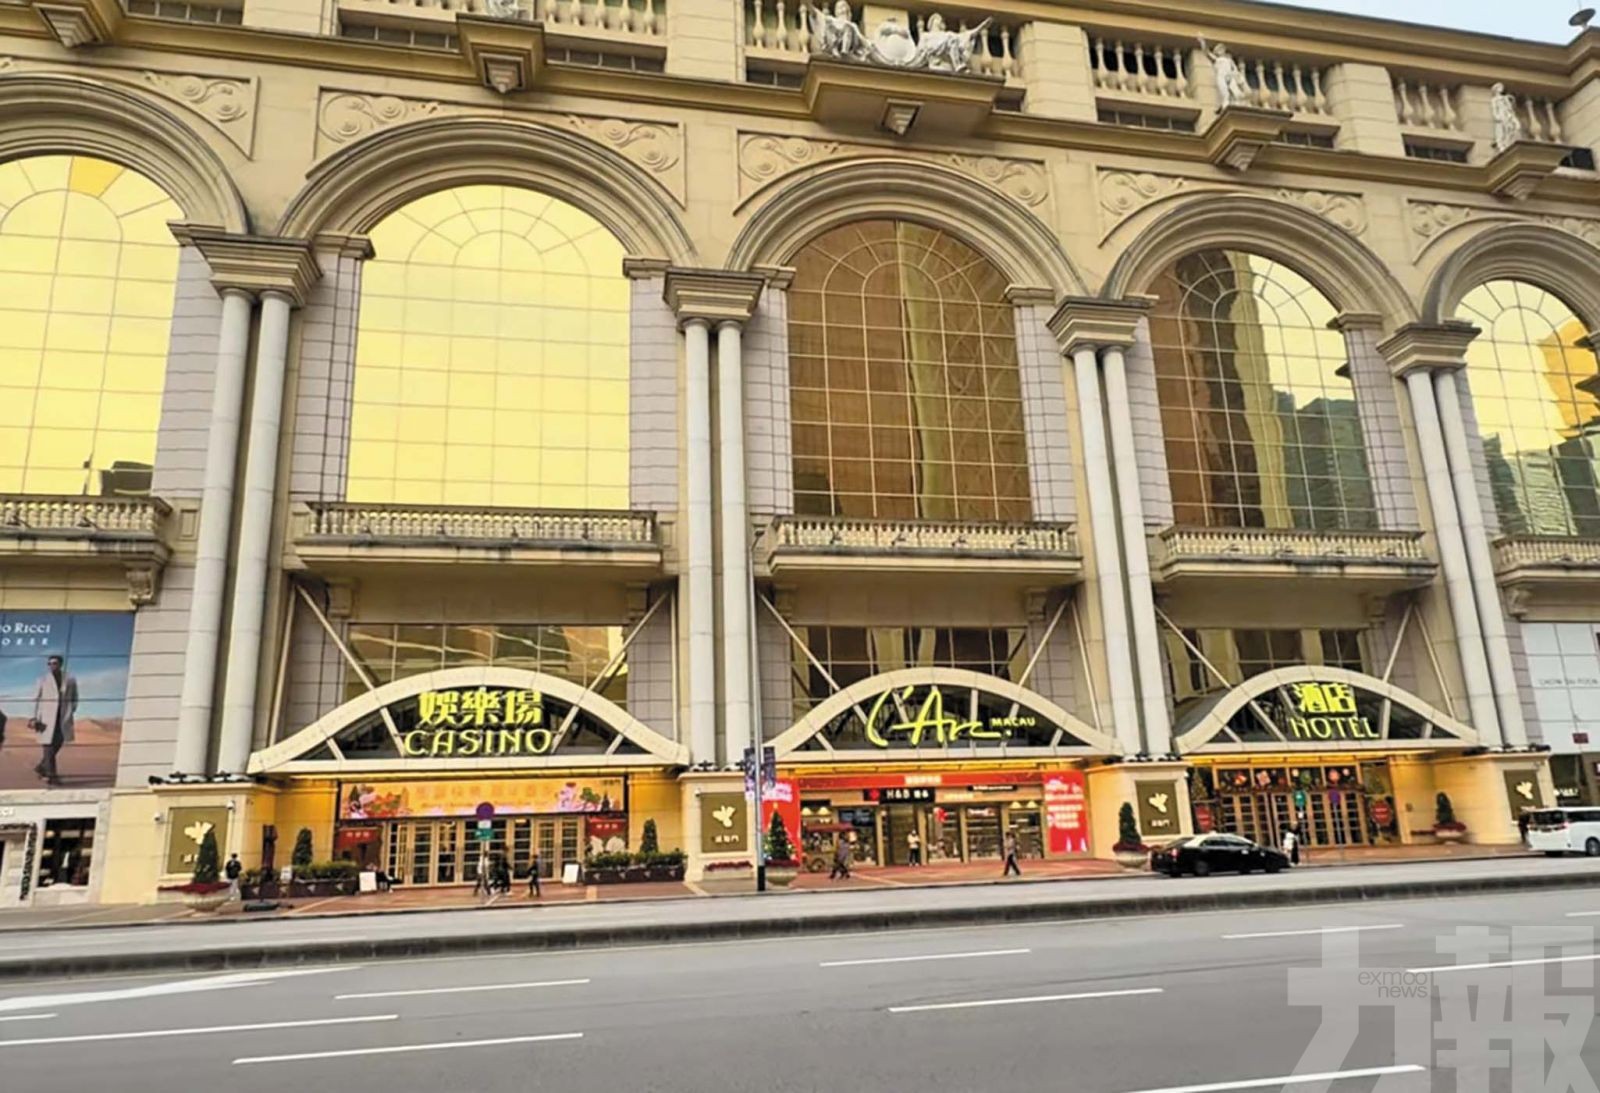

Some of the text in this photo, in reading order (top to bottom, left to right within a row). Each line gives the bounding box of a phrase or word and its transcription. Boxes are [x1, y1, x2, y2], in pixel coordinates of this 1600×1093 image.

[1292, 683, 1356, 712] 酒店
[991, 717, 1036, 727] MACAU
[1290, 717, 1379, 738] HOTEL
[404, 729, 551, 756] CASINO
